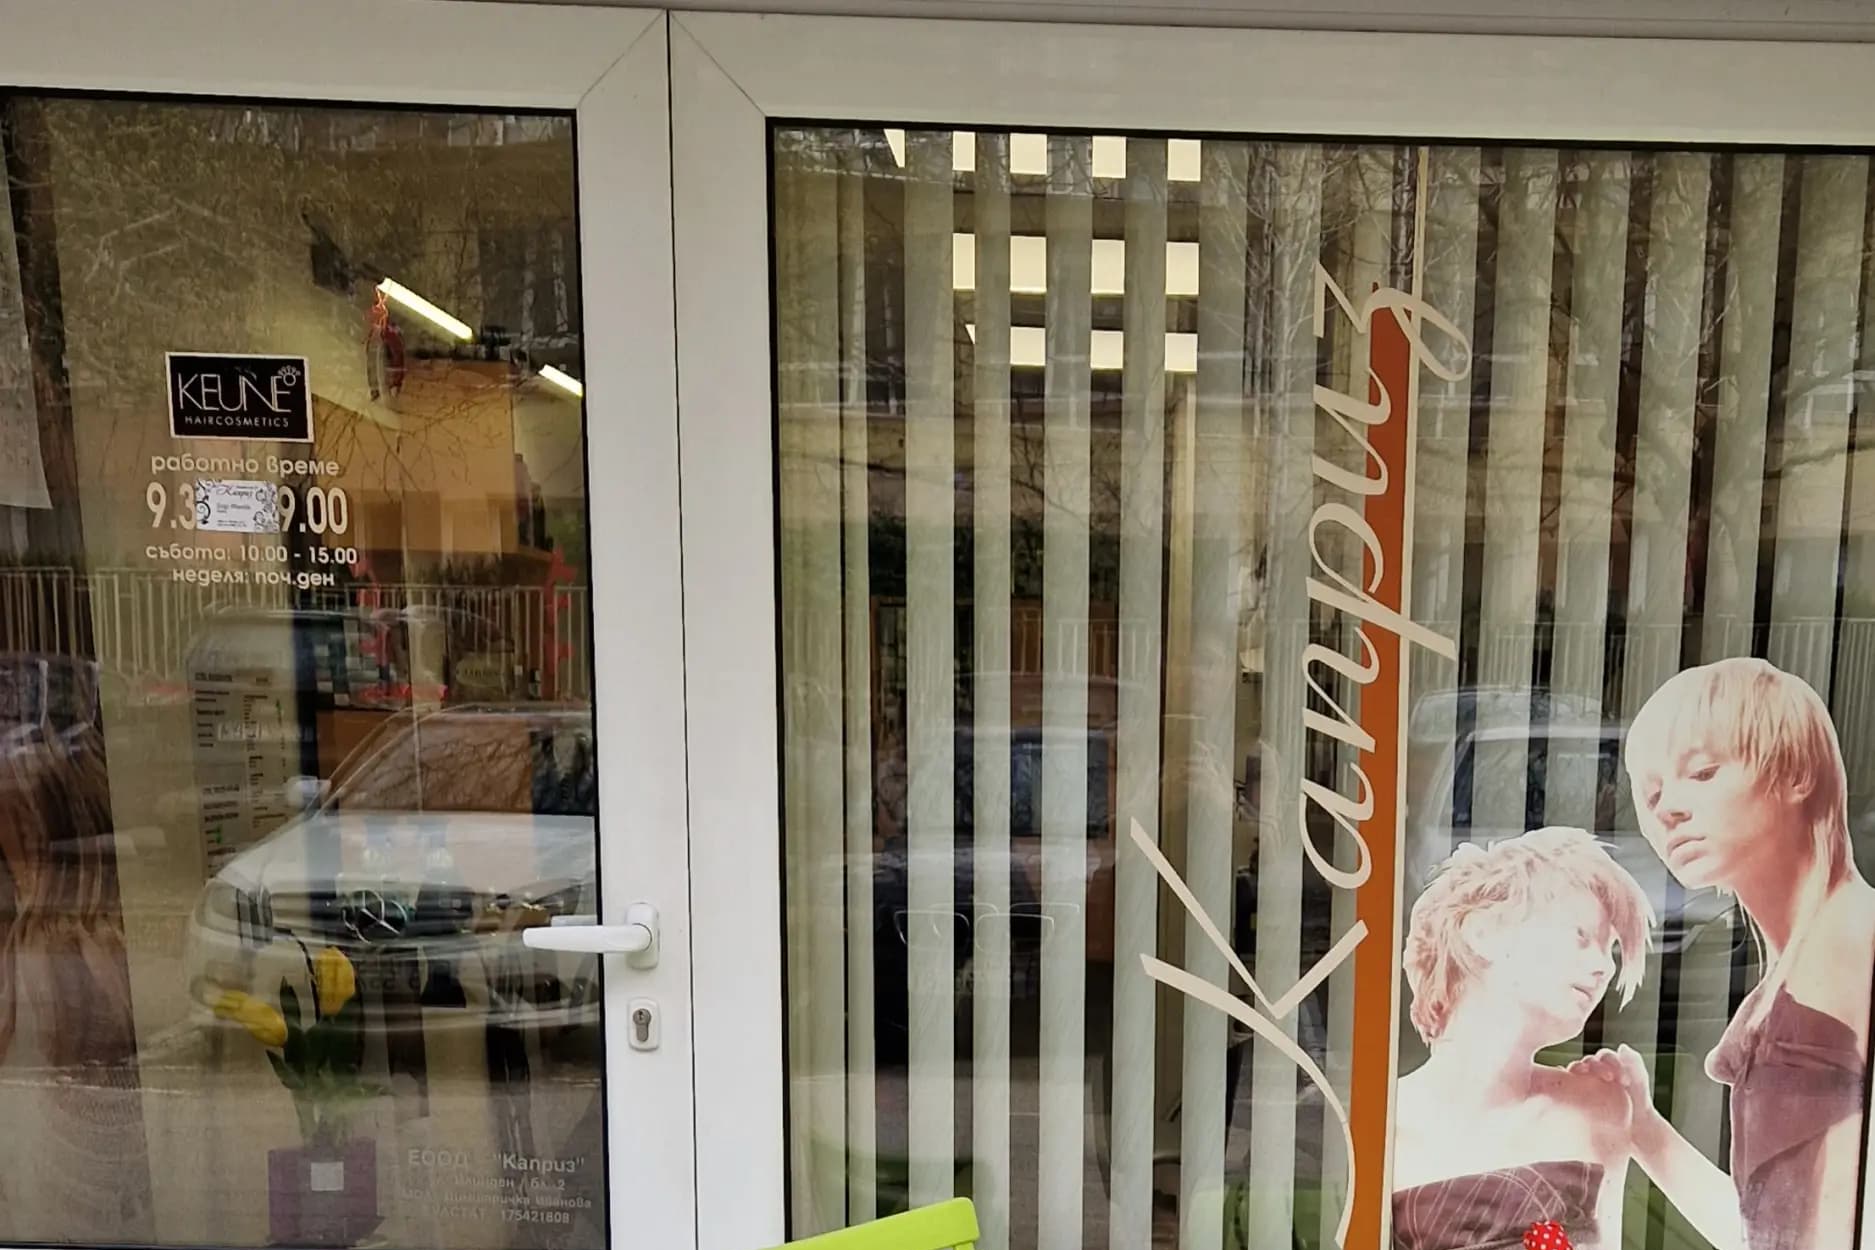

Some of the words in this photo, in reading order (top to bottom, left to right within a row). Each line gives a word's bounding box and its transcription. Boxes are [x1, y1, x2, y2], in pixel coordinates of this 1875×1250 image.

[178, 372, 293, 413] KEUNE
[185, 415, 289, 428] HAIRCOSMETICS
[151, 453, 259, 475] работно
[266, 455, 340, 476] време
[146, 482, 196, 529] 9.3
[277, 486, 348, 534] 9.00
[146, 543, 231, 560] събота:
[240, 545, 288, 562] 10.00
[309, 546, 358, 564] 15.00
[173, 568, 249, 586] неделя:
[255, 569, 335, 588] поч.ден
[408, 1149, 469, 1170] ЕООД
[494, 1153, 585, 1174] "Каприз"
[557, 1179, 566, 1191] 2
